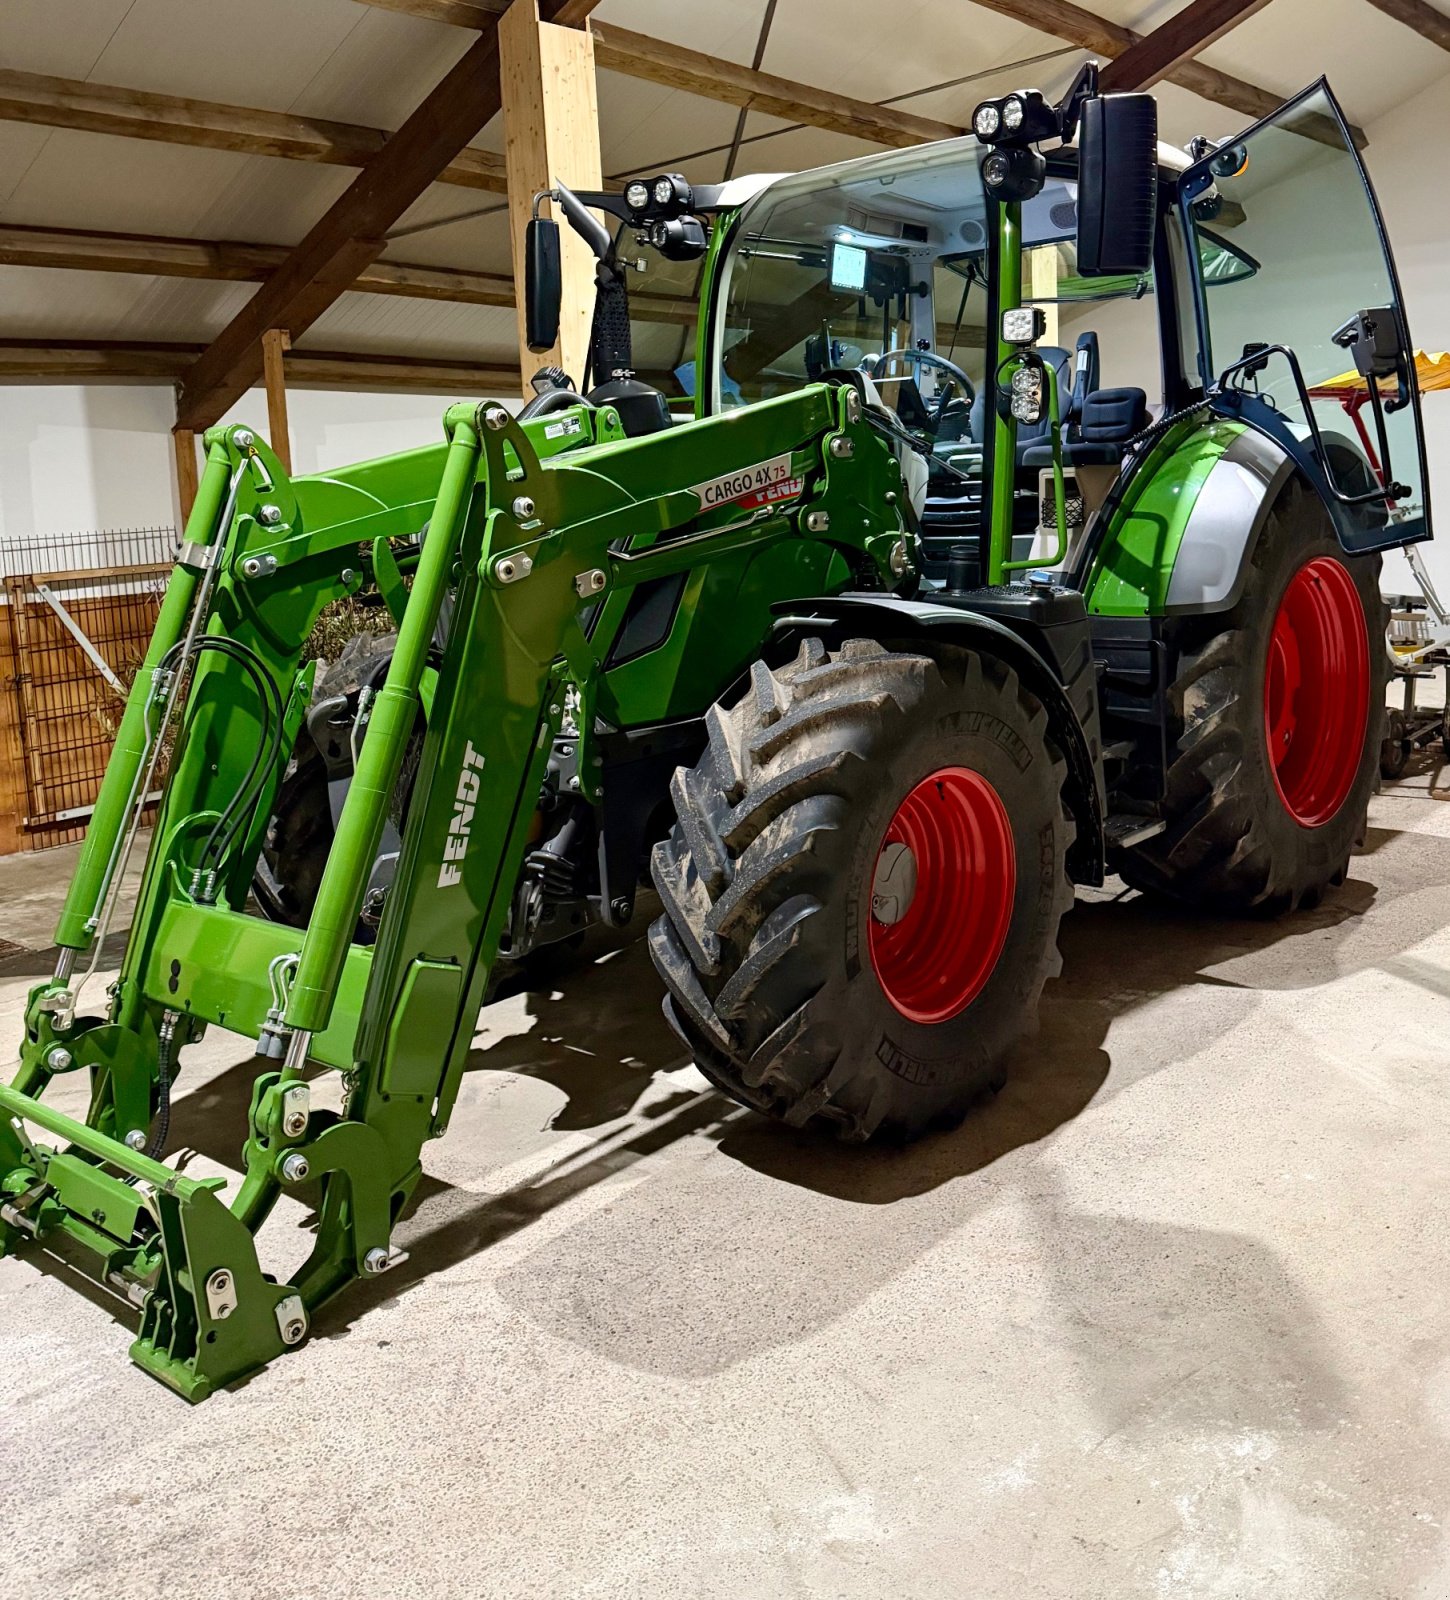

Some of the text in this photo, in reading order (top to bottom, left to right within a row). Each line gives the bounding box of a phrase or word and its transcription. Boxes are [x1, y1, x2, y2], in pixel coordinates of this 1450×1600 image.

[705, 465, 786, 504] CARGO 4X 75
[437, 739, 486, 889] FENDT
